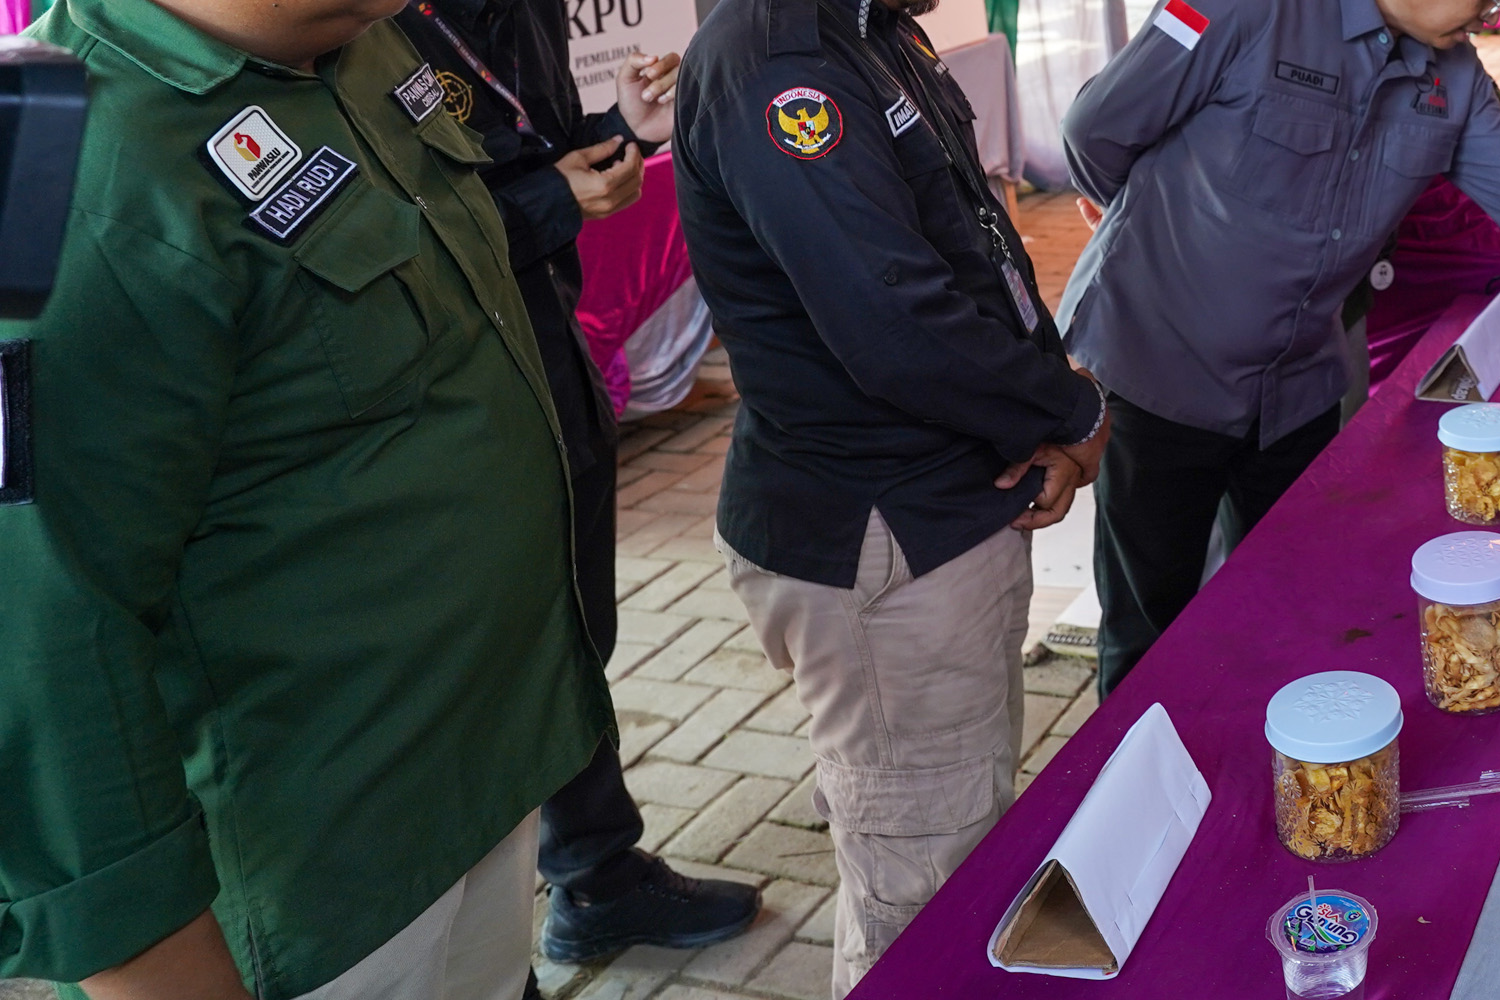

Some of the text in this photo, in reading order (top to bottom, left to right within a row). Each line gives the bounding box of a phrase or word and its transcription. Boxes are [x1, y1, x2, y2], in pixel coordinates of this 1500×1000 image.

[1290, 69, 1324, 87] PUADI
[776, 90, 821, 105] INDONESIA
[247, 147, 281, 181] PANWASLU
[265, 188, 311, 225] HADI
[296, 158, 339, 196] RUDI
